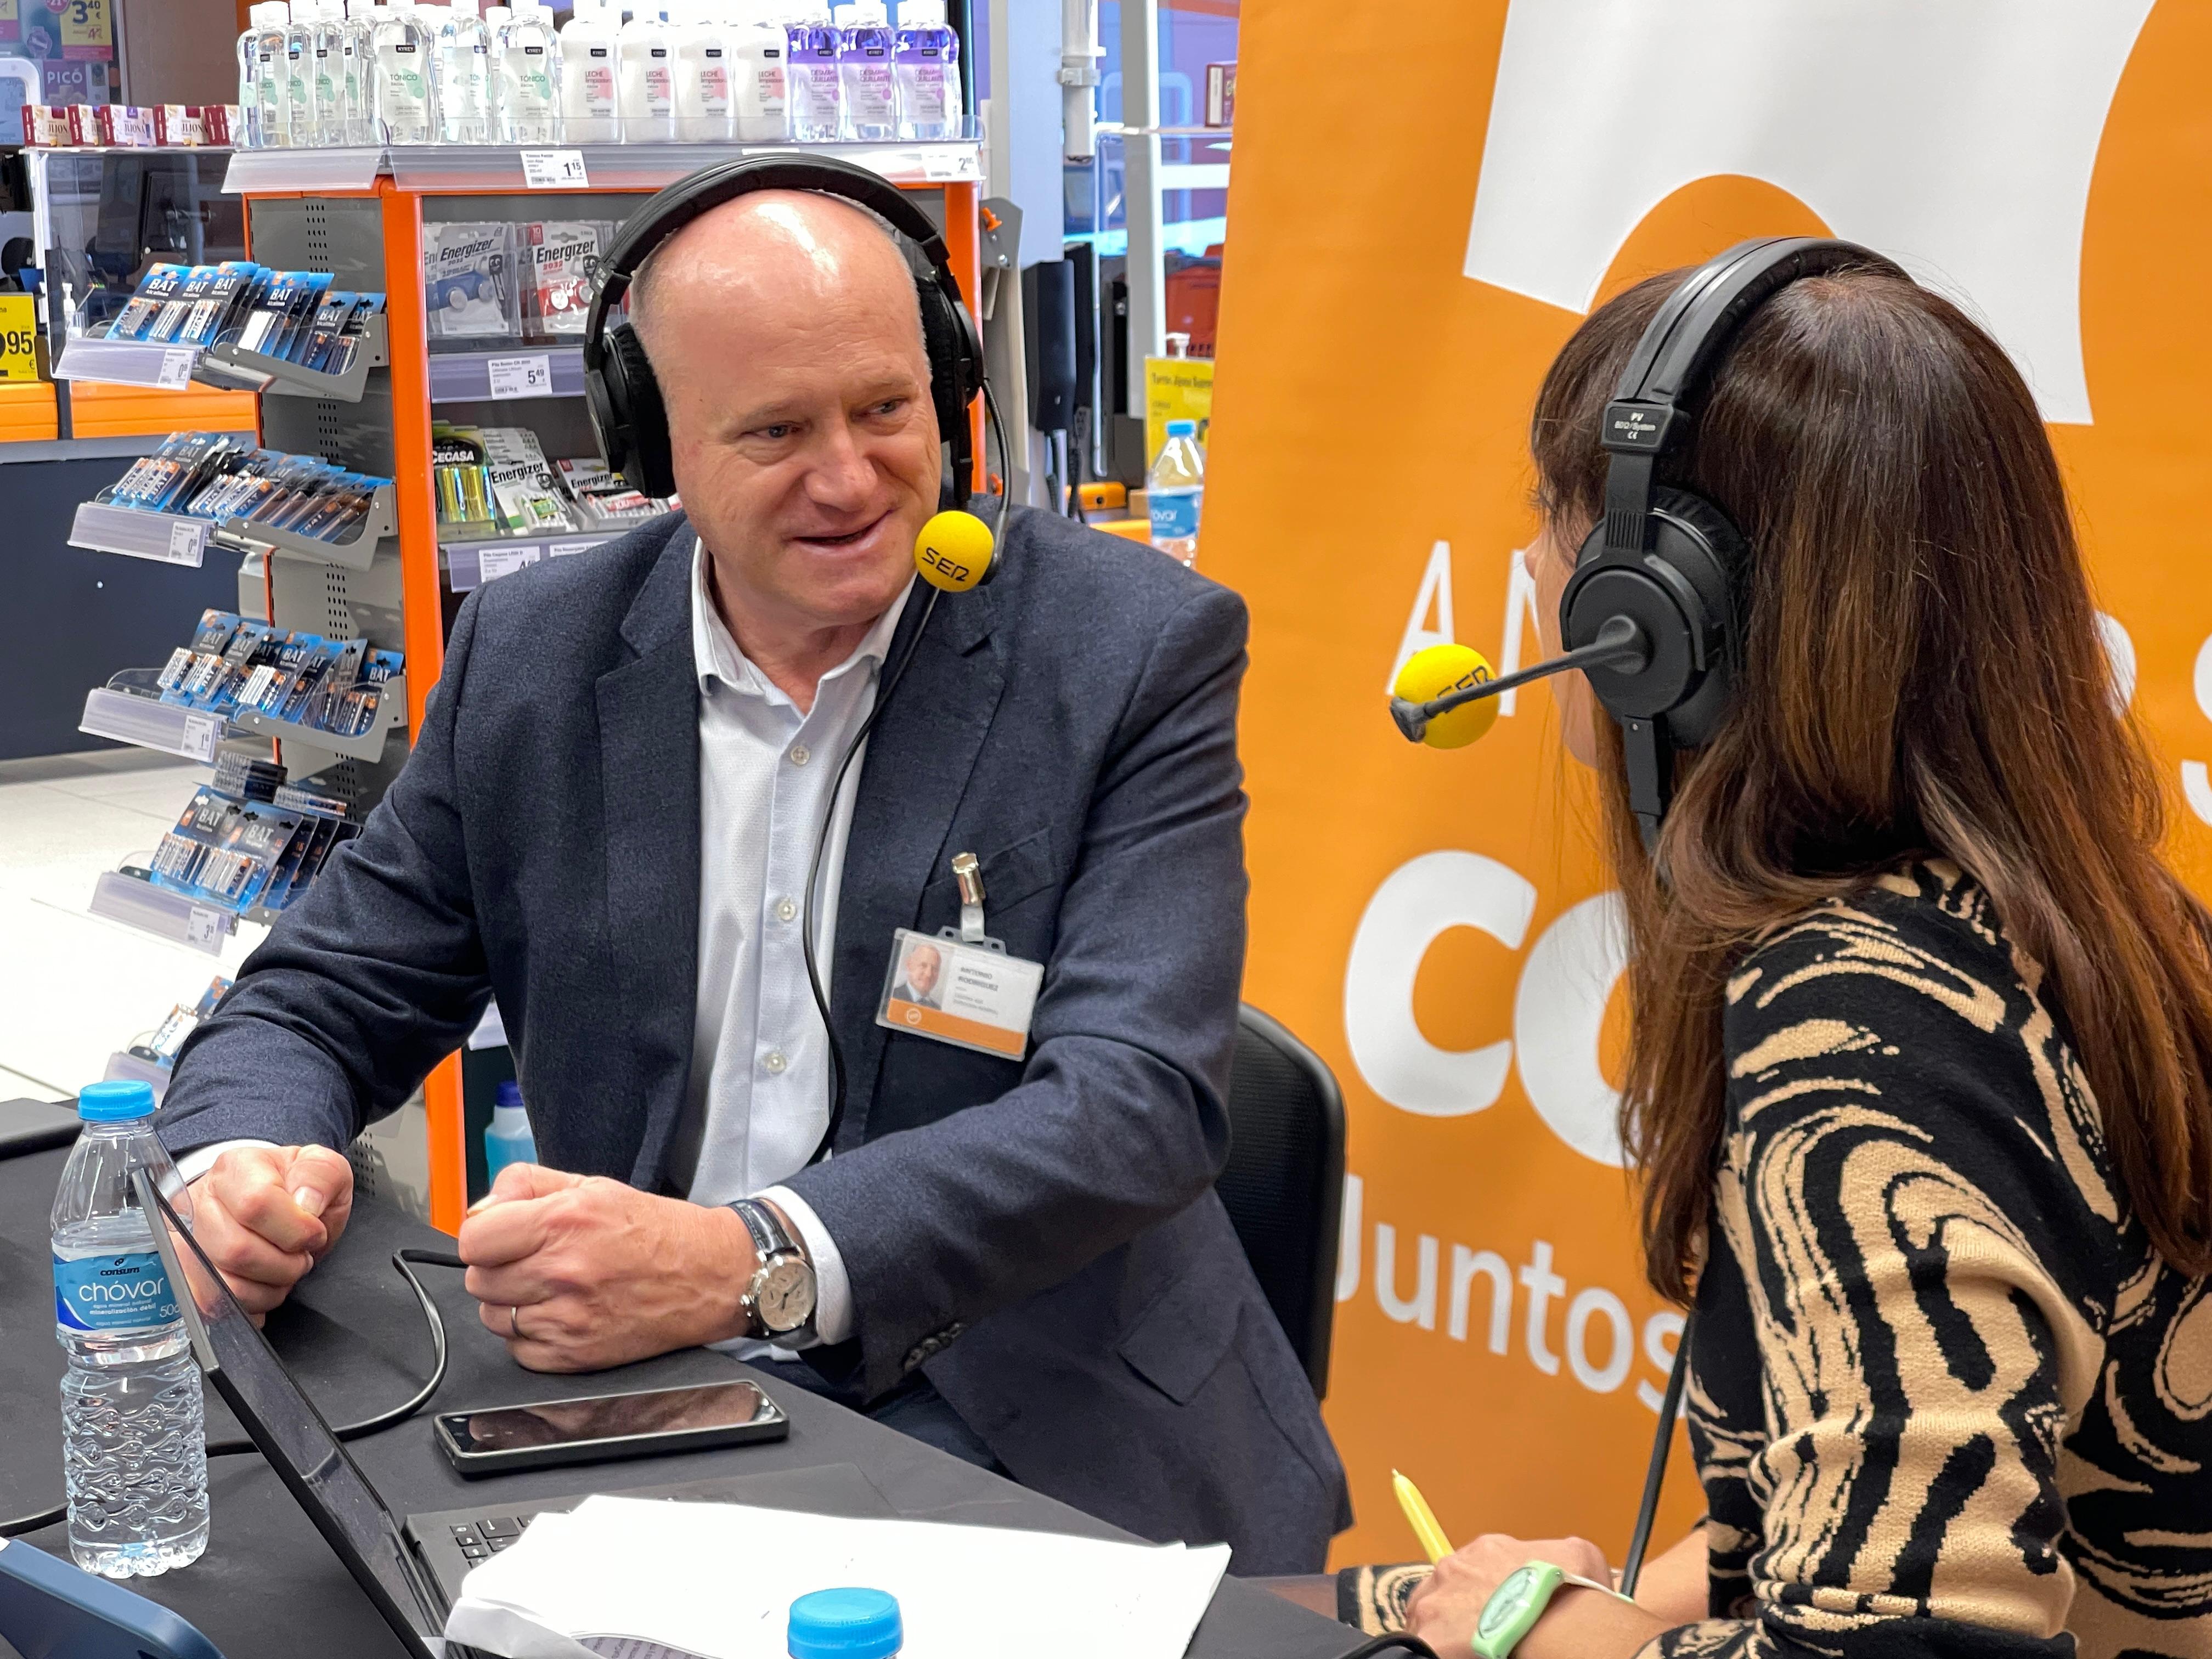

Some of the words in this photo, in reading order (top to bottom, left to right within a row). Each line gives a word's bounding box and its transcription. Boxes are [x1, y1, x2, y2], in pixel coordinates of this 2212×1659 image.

[72, 1, 88, 24] 3
[47, 67, 83, 84] PICÓ
[390, 73, 418, 81] TÓNICO
[470, 73, 489, 81] TÓNO
[563, 162, 571, 176] 1
[572, 162, 582, 170] 15
[958, 157, 967, 171] 2
[441, 239, 494, 261] Energizer
[536, 240, 595, 263] Energizer
[149, 278, 178, 292] BAT
[186, 281, 208, 293] BAT
[214, 278, 236, 290] BAT
[269, 288, 293, 301] BAT
[319, 309, 343, 321] BAT
[7, 331, 33, 355] 95
[528, 370, 536, 384] 5
[178, 445, 201, 458] BAT
[490, 462, 544, 484] Energizer
[571, 473, 613, 488] Energizer
[922, 546, 970, 582] SER
[202, 631, 223, 645] BAT
[231, 638, 253, 652] BAT
[283, 648, 306, 663] BAT
[311, 656, 327, 668] AT
[369, 666, 391, 682] BAT
[199, 807, 222, 827] BAT
[249, 824, 274, 843] BAT
[100, 1267, 140, 1277] consum
[79, 1277, 164, 1302] chóvar
[1335, 1173, 1688, 1418] Juntos
[89, 1307, 138, 1315] mineralización
